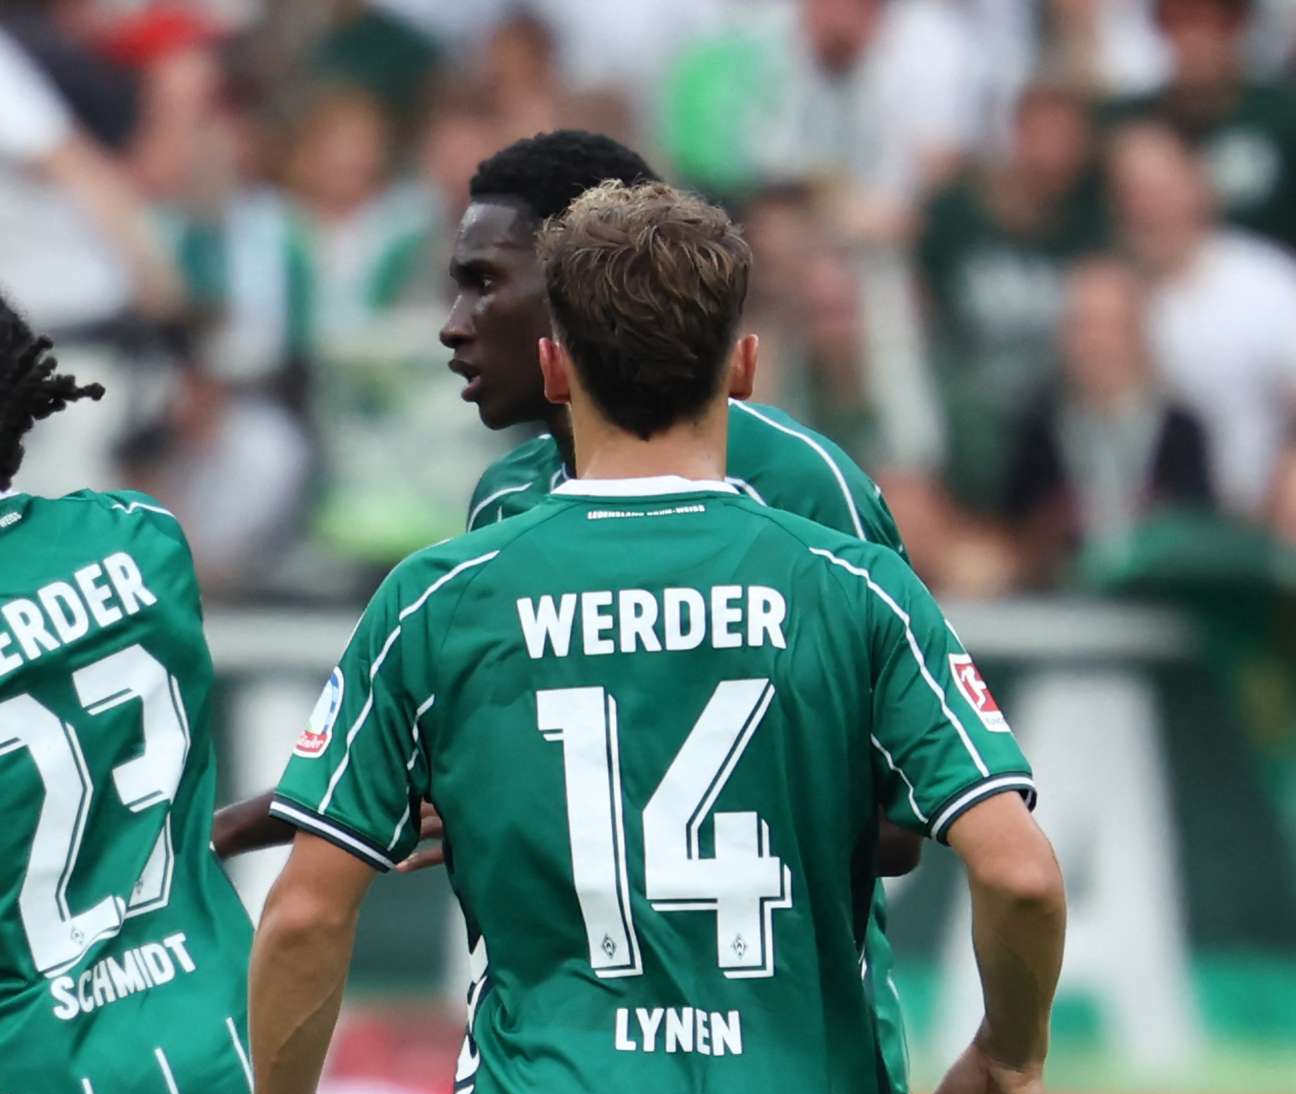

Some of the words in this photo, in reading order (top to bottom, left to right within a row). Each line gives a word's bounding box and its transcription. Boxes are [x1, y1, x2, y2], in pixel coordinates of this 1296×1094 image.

[516, 585, 787, 660] WERDER
[535, 677, 792, 980] 14
[48, 932, 196, 1021] SCHMIDT
[614, 1006, 743, 1057] LYNEN
